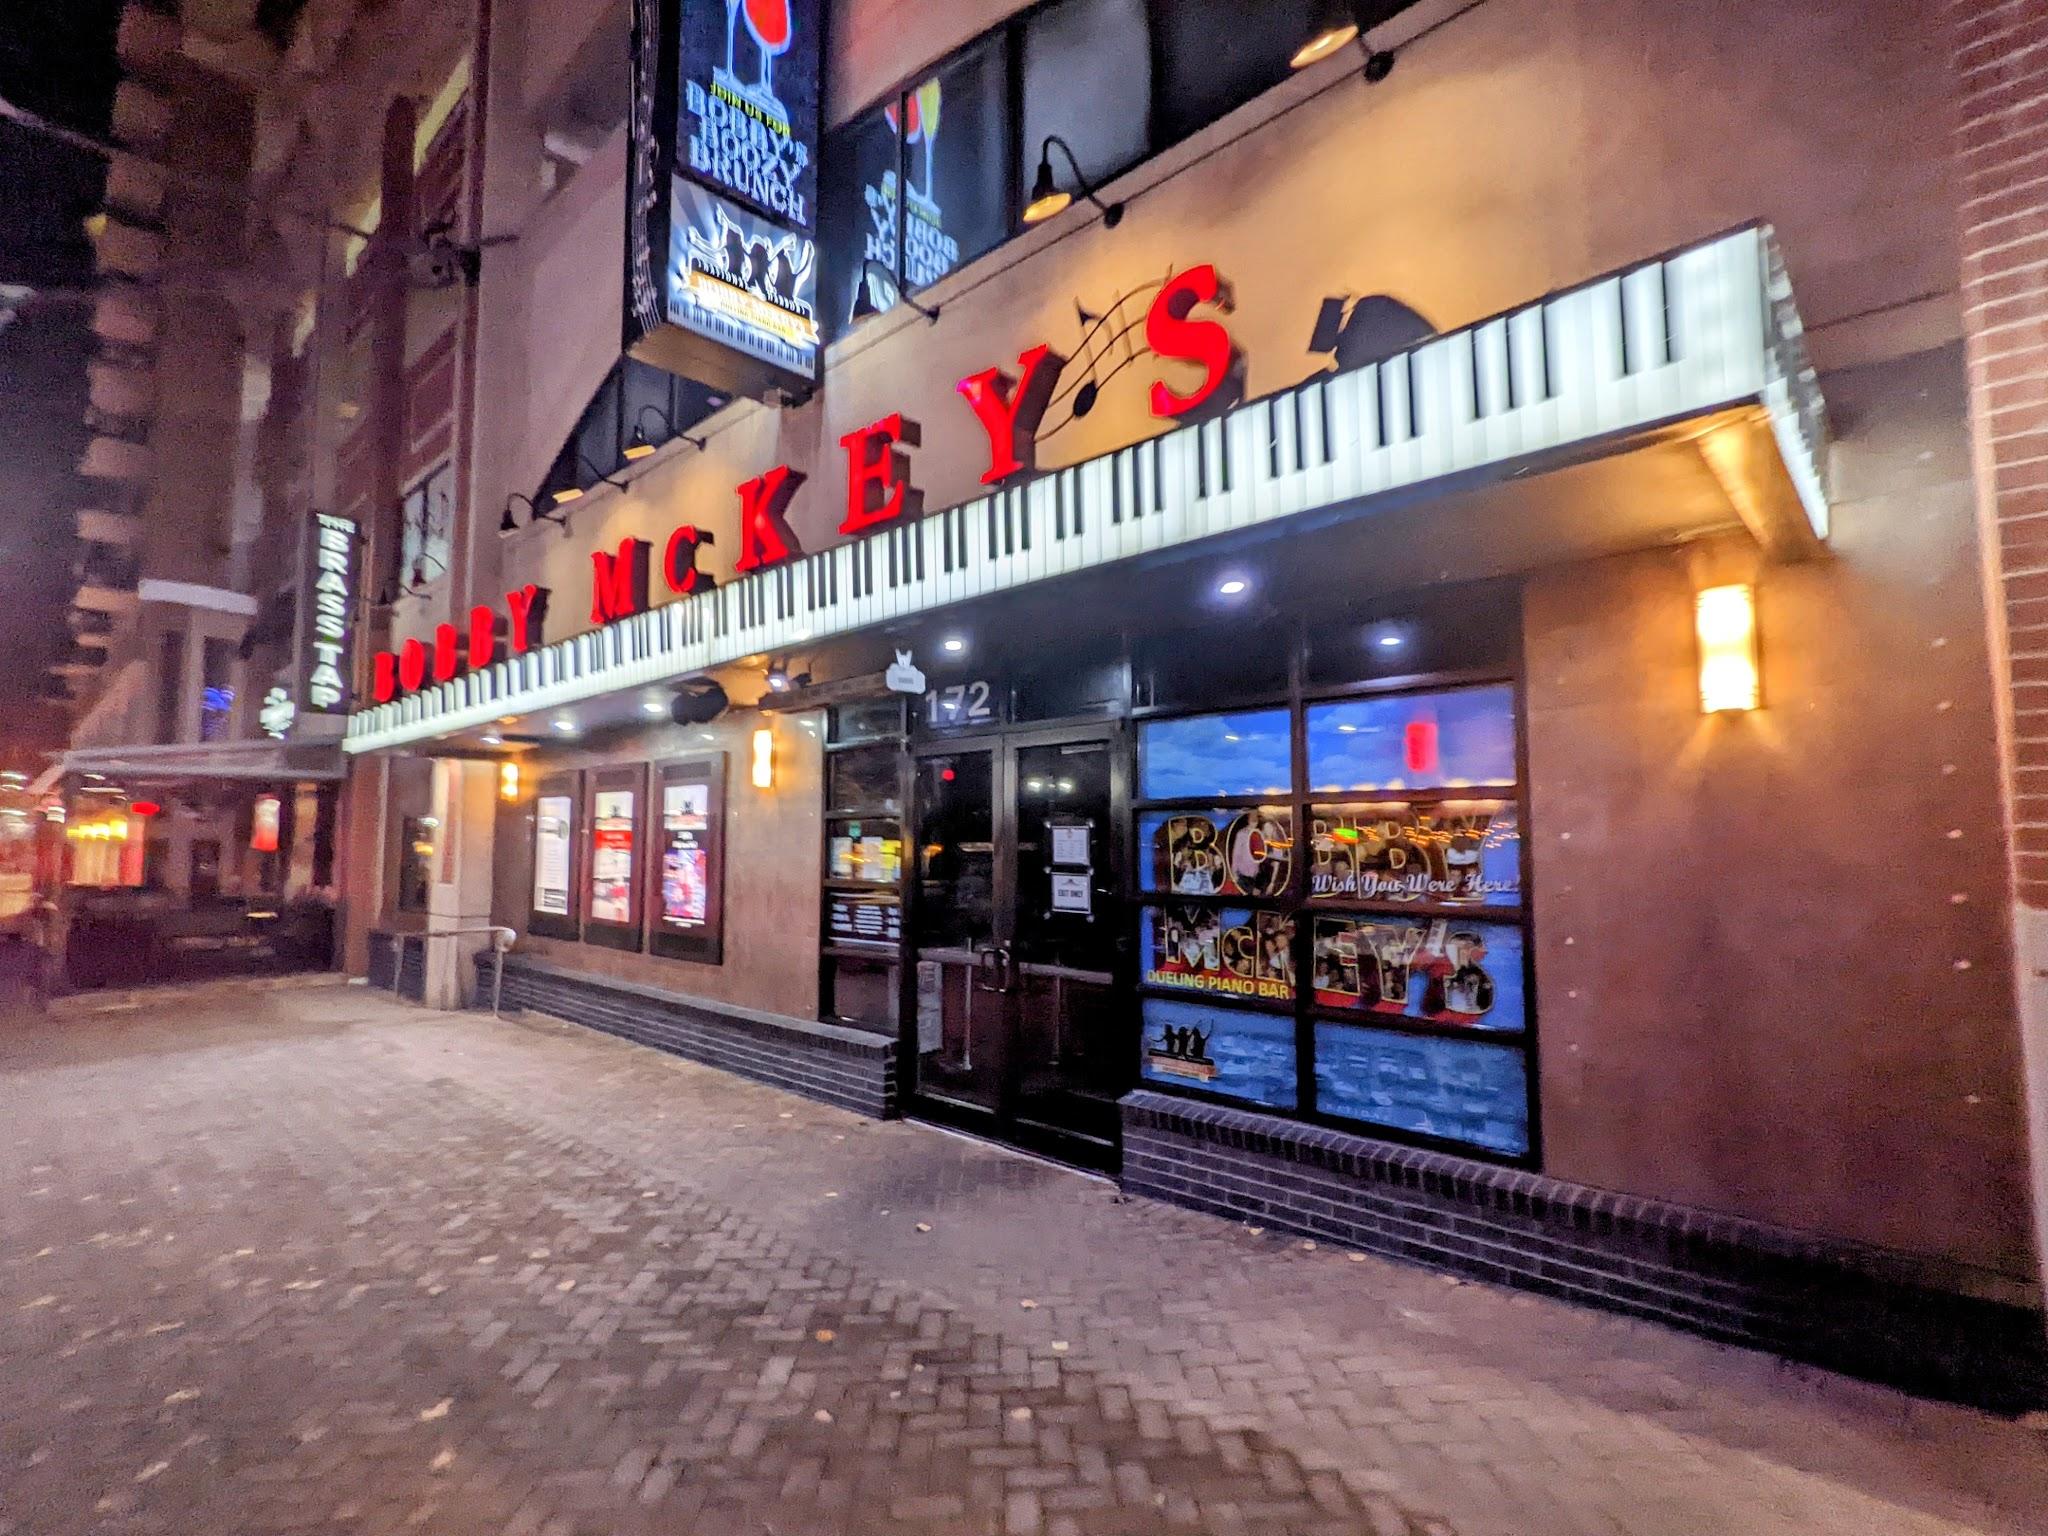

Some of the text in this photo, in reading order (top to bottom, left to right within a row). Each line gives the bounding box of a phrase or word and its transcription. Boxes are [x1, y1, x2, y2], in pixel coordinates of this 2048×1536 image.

[690, 134, 807, 226] BRUNCH
[314, 527, 349, 638] BRASS
[310, 642, 344, 708] TAP
[374, 584, 537, 702] BOBBY
[926, 681, 991, 722] 172
[1312, 873, 1357, 893] Wish
[1359, 873, 1401, 899] You
[1403, 873, 1457, 893] Were
[1146, 969, 1290, 999] DUELING PIANO BAR
